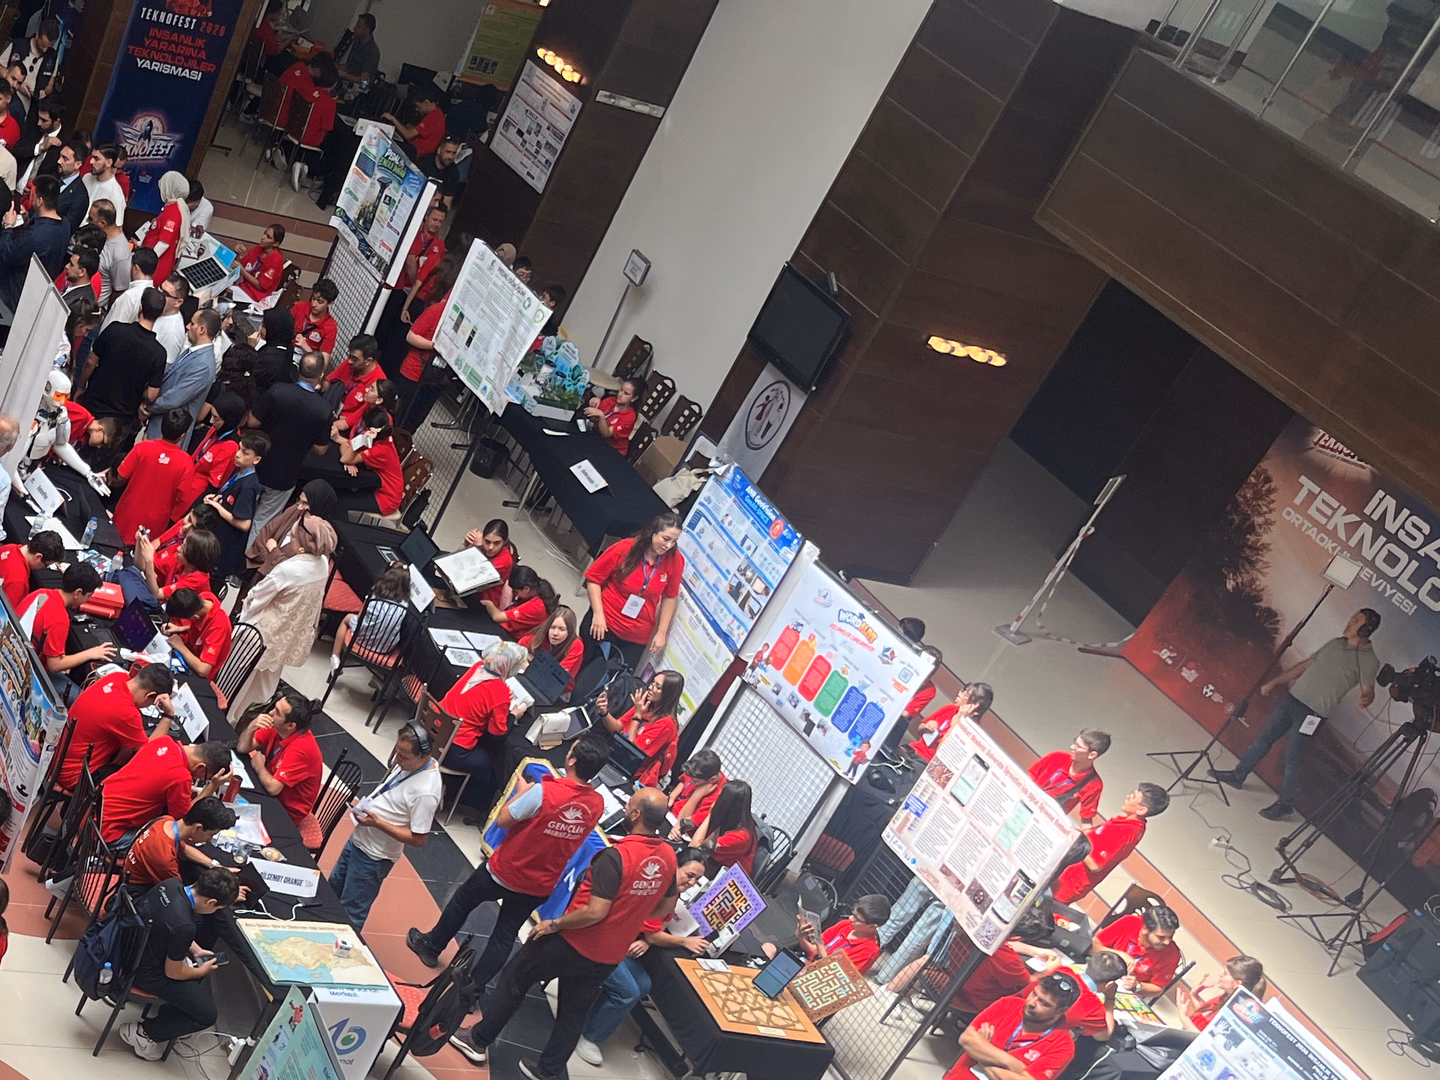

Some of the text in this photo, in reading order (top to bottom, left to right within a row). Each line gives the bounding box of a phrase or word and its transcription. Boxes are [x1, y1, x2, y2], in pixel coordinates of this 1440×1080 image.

[140, 7, 197, 30] TEKNOFEST
[136, 58, 203, 81] YARIŞMASI
[283, 874, 304, 888] ORANGE
[1267, 1016, 1297, 1044] TEKNOFEST
